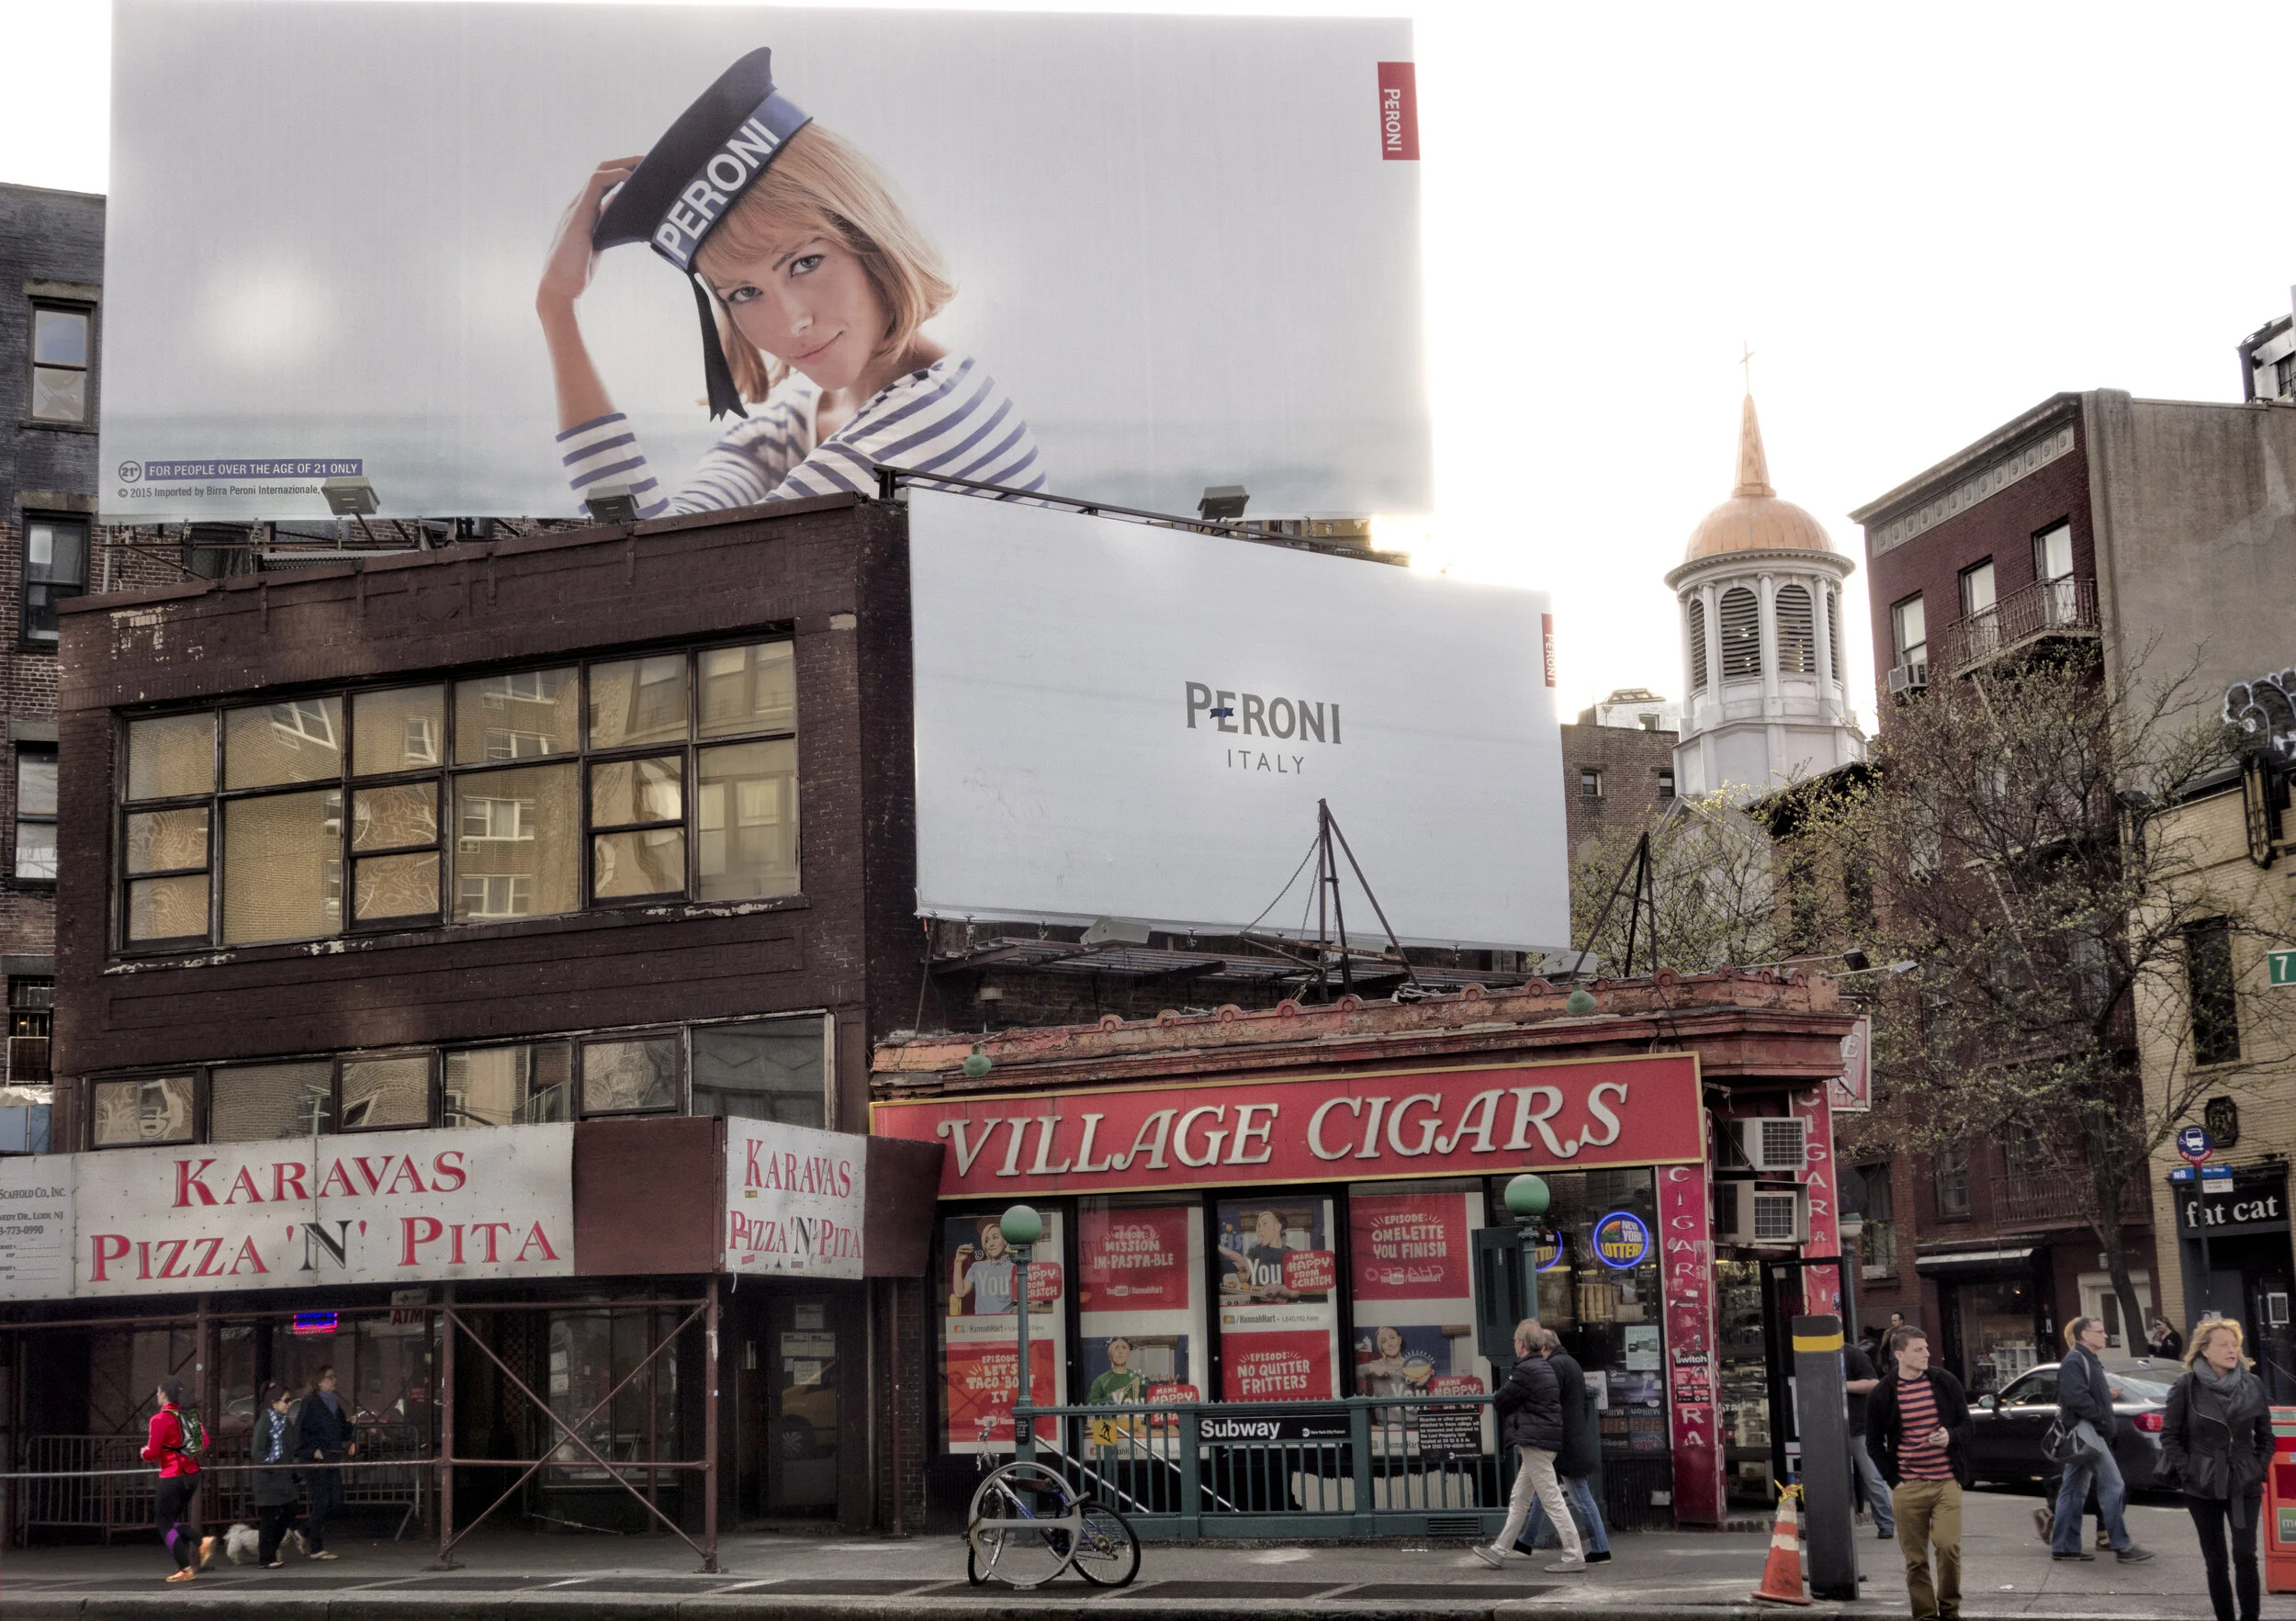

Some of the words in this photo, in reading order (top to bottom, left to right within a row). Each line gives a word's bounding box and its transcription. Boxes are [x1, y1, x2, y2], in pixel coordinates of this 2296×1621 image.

[1384, 88, 1402, 151] PERONI
[656, 118, 780, 261] PERONI
[149, 466, 171, 477] FOR
[174, 465, 215, 476] PEOPLE
[219, 464, 246, 475] OVER
[249, 464, 270, 474] THE
[273, 463, 295, 474] AGE
[298, 463, 311, 474] OF
[314, 463, 327, 474] 21
[330, 462, 358, 474] ONLY
[130, 487, 152, 499] 2015
[154, 486, 192, 498] Imported
[194, 486, 205, 497] by
[207, 485, 228, 496] Birra
[231, 484, 256, 496] Peroni
[258, 483, 321, 496] Internazionale,
[1545, 633, 1557, 681] PERONI
[1185, 681, 1342, 745] PERONI
[1228, 749, 1304, 774] ITALY
[2275, 955, 2288, 981] 7
[937, 1103, 1279, 1177] VILLAGE
[1307, 1083, 1628, 1161] CIGARS
[744, 1138, 851, 1199] KARAVAS
[172, 1150, 467, 1209] KARAVAS
[54, 1211, 63, 1220] NJ
[2233, 1196, 2279, 1221] cat
[1384, 1213, 1427, 1225] EPISODE:
[1621, 1220, 1638, 1231] NEW
[728, 1210, 788, 1254] PIZZA
[818, 1219, 861, 1259] PITA
[1372, 1225, 1445, 1242] OMELETTE
[1623, 1230, 1642, 1243] YORK
[88, 1233, 270, 1283] PIZZA
[397, 1216, 561, 1267] PITA
[1106, 1241, 1160, 1252] MISSION
[1373, 1244, 1397, 1259] YOU
[1401, 1242, 1447, 1258] FINISH
[1601, 1243, 1644, 1259] LOTTERY
[1094, 1253, 1174, 1269] IM-PASTA-BLE
[1289, 1256, 1331, 1273] HAPPY
[1292, 1253, 1314, 1262] MAKE
[1244, 1258, 1283, 1286] You
[1293, 1269, 1320, 1279] FROM
[976, 1270, 1010, 1296] You
[1291, 1274, 1333, 1288] SCRATCH
[392, 1309, 423, 1325] ATM
[1250, 1352, 1290, 1362] EPISODE:
[984, 1364, 1019, 1377] LET'S
[1237, 1364, 1255, 1378] NO
[1258, 1359, 1311, 1375] QUITTER
[966, 1377, 999, 1390] TACO
[1155, 1387, 1177, 1395] MAKE
[1242, 1375, 1308, 1395] FRITTERS
[1435, 1384, 1478, 1396] HAPPY
[991, 1390, 1008, 1403] IT
[1152, 1391, 1193, 1404] HAPPY
[1200, 1419, 1280, 1440] Subway
